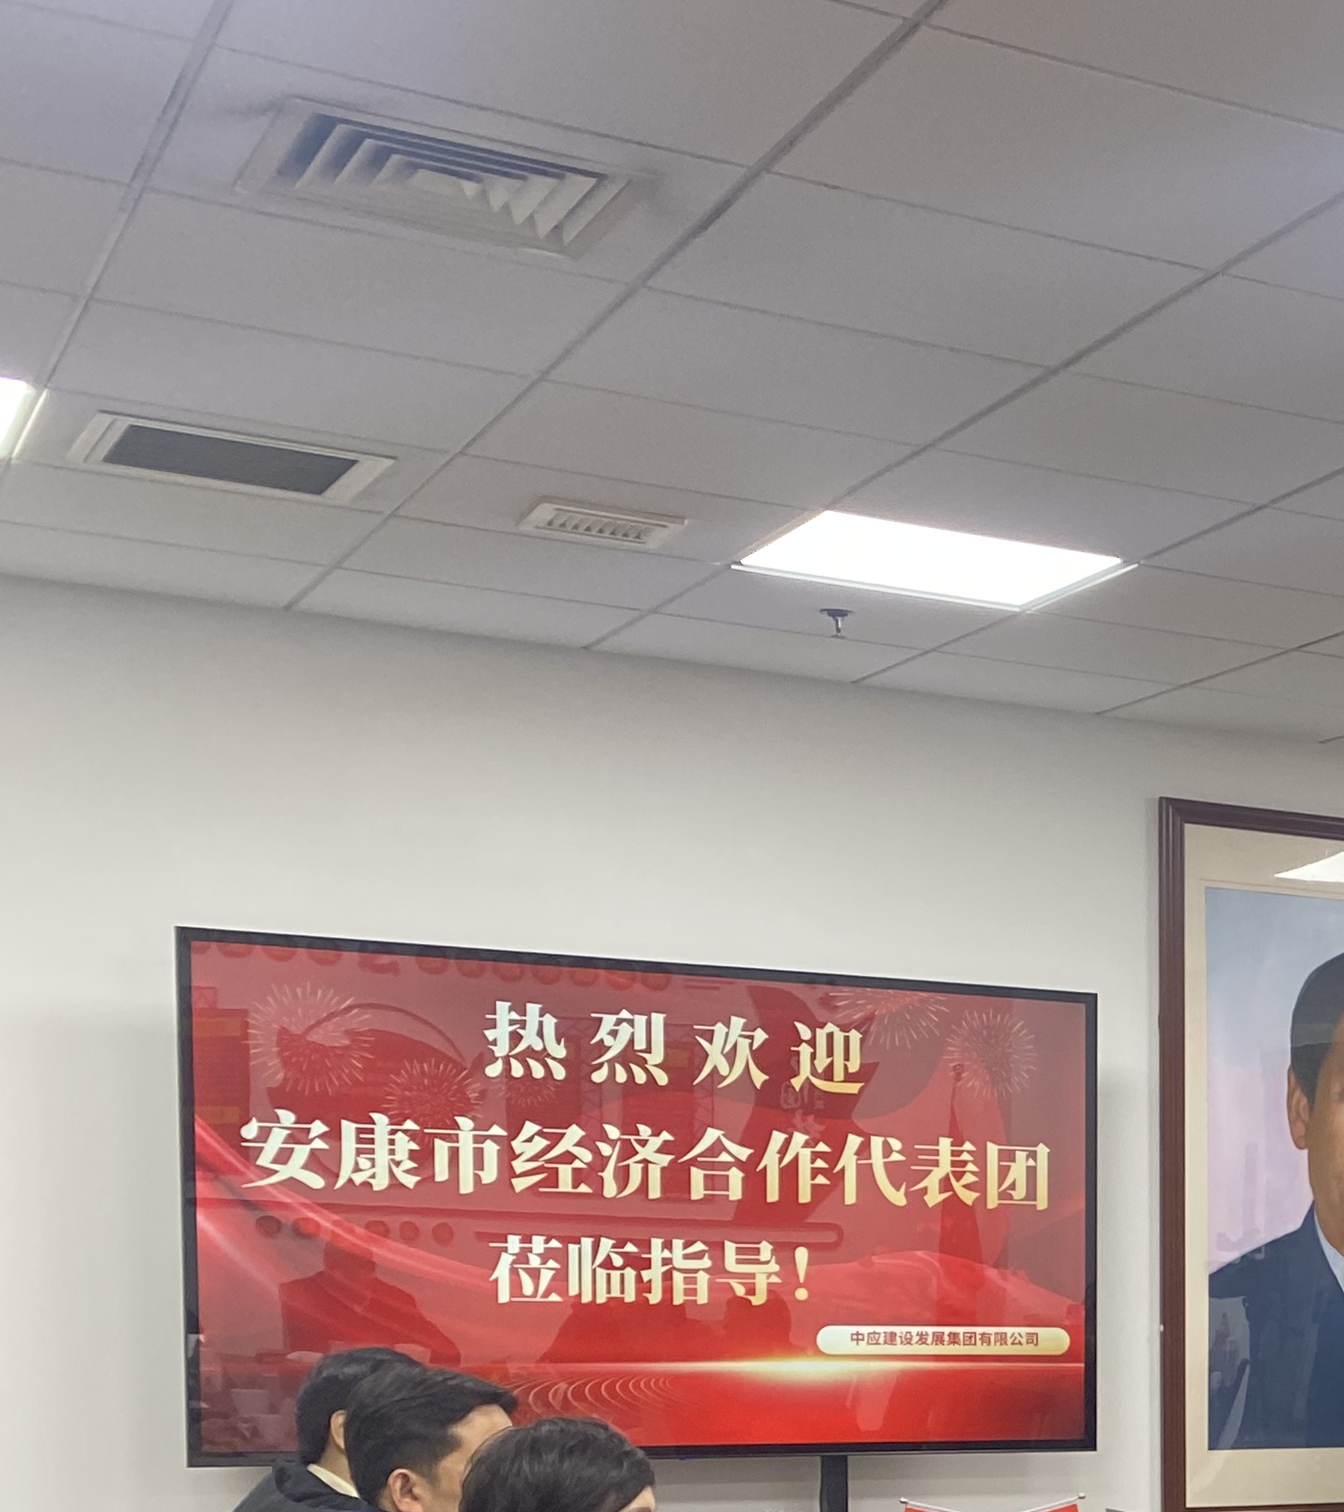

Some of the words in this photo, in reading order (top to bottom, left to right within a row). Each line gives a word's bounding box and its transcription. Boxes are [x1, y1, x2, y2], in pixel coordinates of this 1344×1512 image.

[484, 1000, 864, 1097] 热烈欢迎
[240, 1107, 1052, 1212] 安康市经济合作代表团
[850, 1330, 1039, 1347] 中应建设发展集团有限公司
